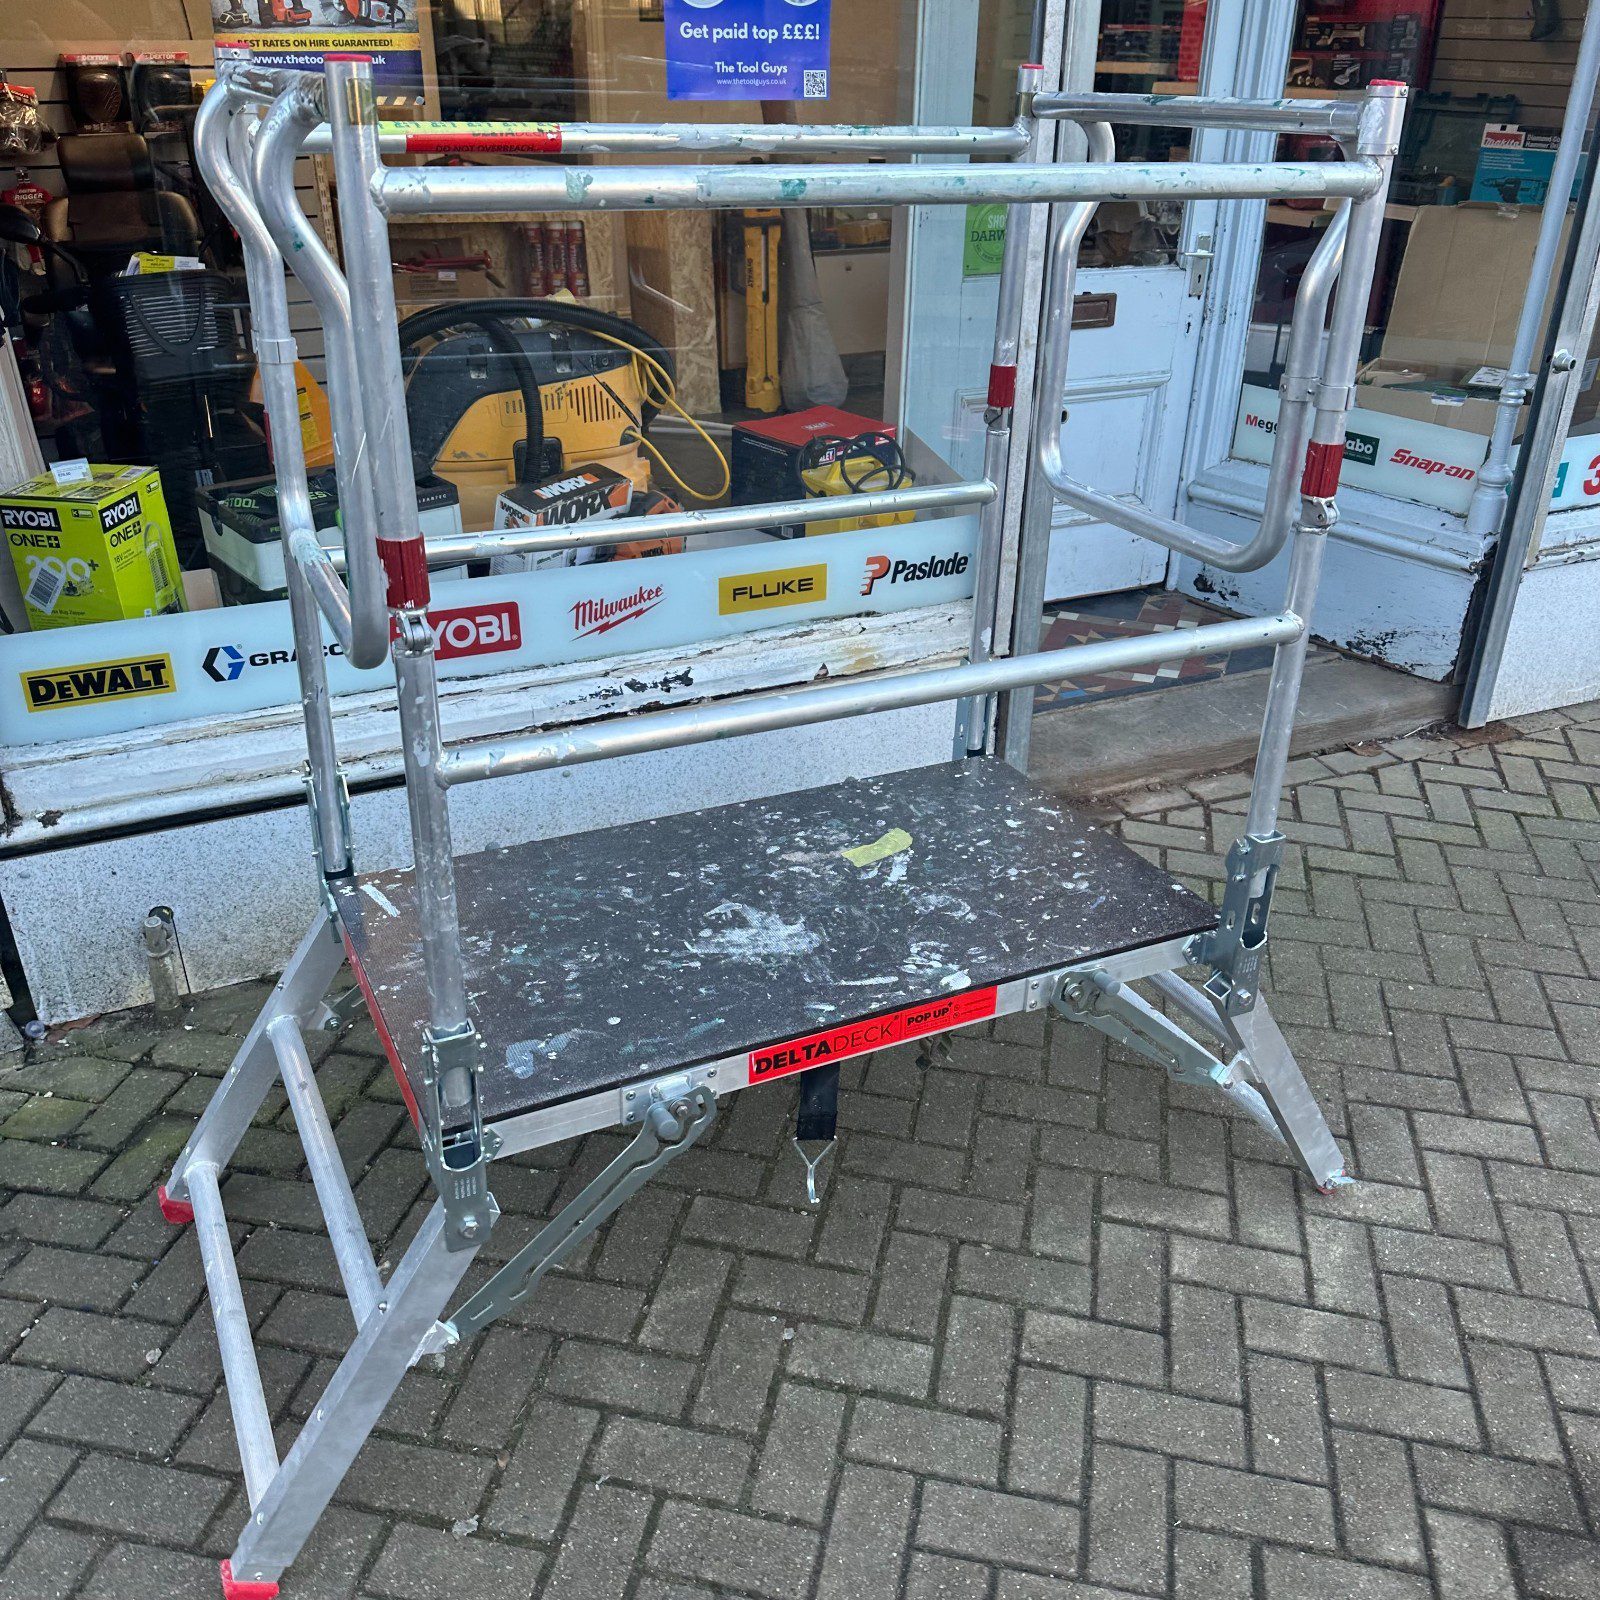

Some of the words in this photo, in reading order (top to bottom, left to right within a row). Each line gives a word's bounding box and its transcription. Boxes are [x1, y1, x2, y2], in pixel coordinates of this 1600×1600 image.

[262, 40, 291, 48] RATES
[293, 40, 307, 48] ON
[309, 39, 330, 47] HIRE
[332, 38, 393, 47] GUARANTEED!
[679, 22, 709, 39] Get
[712, 22, 748, 43] paid
[752, 25, 779, 43] top
[782, 23, 820, 40] £££!
[715, 62, 735, 73] The
[737, 62, 759, 73] Tool
[761, 62, 788, 76] Guys
[716, 78, 787, 86] www.thetoolguys.co.uk
[14, 192, 44, 201] RIGGER
[987, 214, 1007, 229] SHO
[1346, 438, 1374, 455] abo
[1389, 448, 1476, 481] Snap-on
[539, 476, 588, 499] WORX
[1, 509, 56, 528] RYOBI
[102, 497, 138, 528] RYOBI
[543, 489, 613, 526] WORX
[891, 552, 968, 584] Paslode
[732, 577, 813, 602] FLUKE
[567, 585, 664, 630] Milwaukee
[427, 613, 511, 651] YOBI
[907, 1012, 931, 1027] POP
[755, 1026, 893, 1075] DELTADECK
